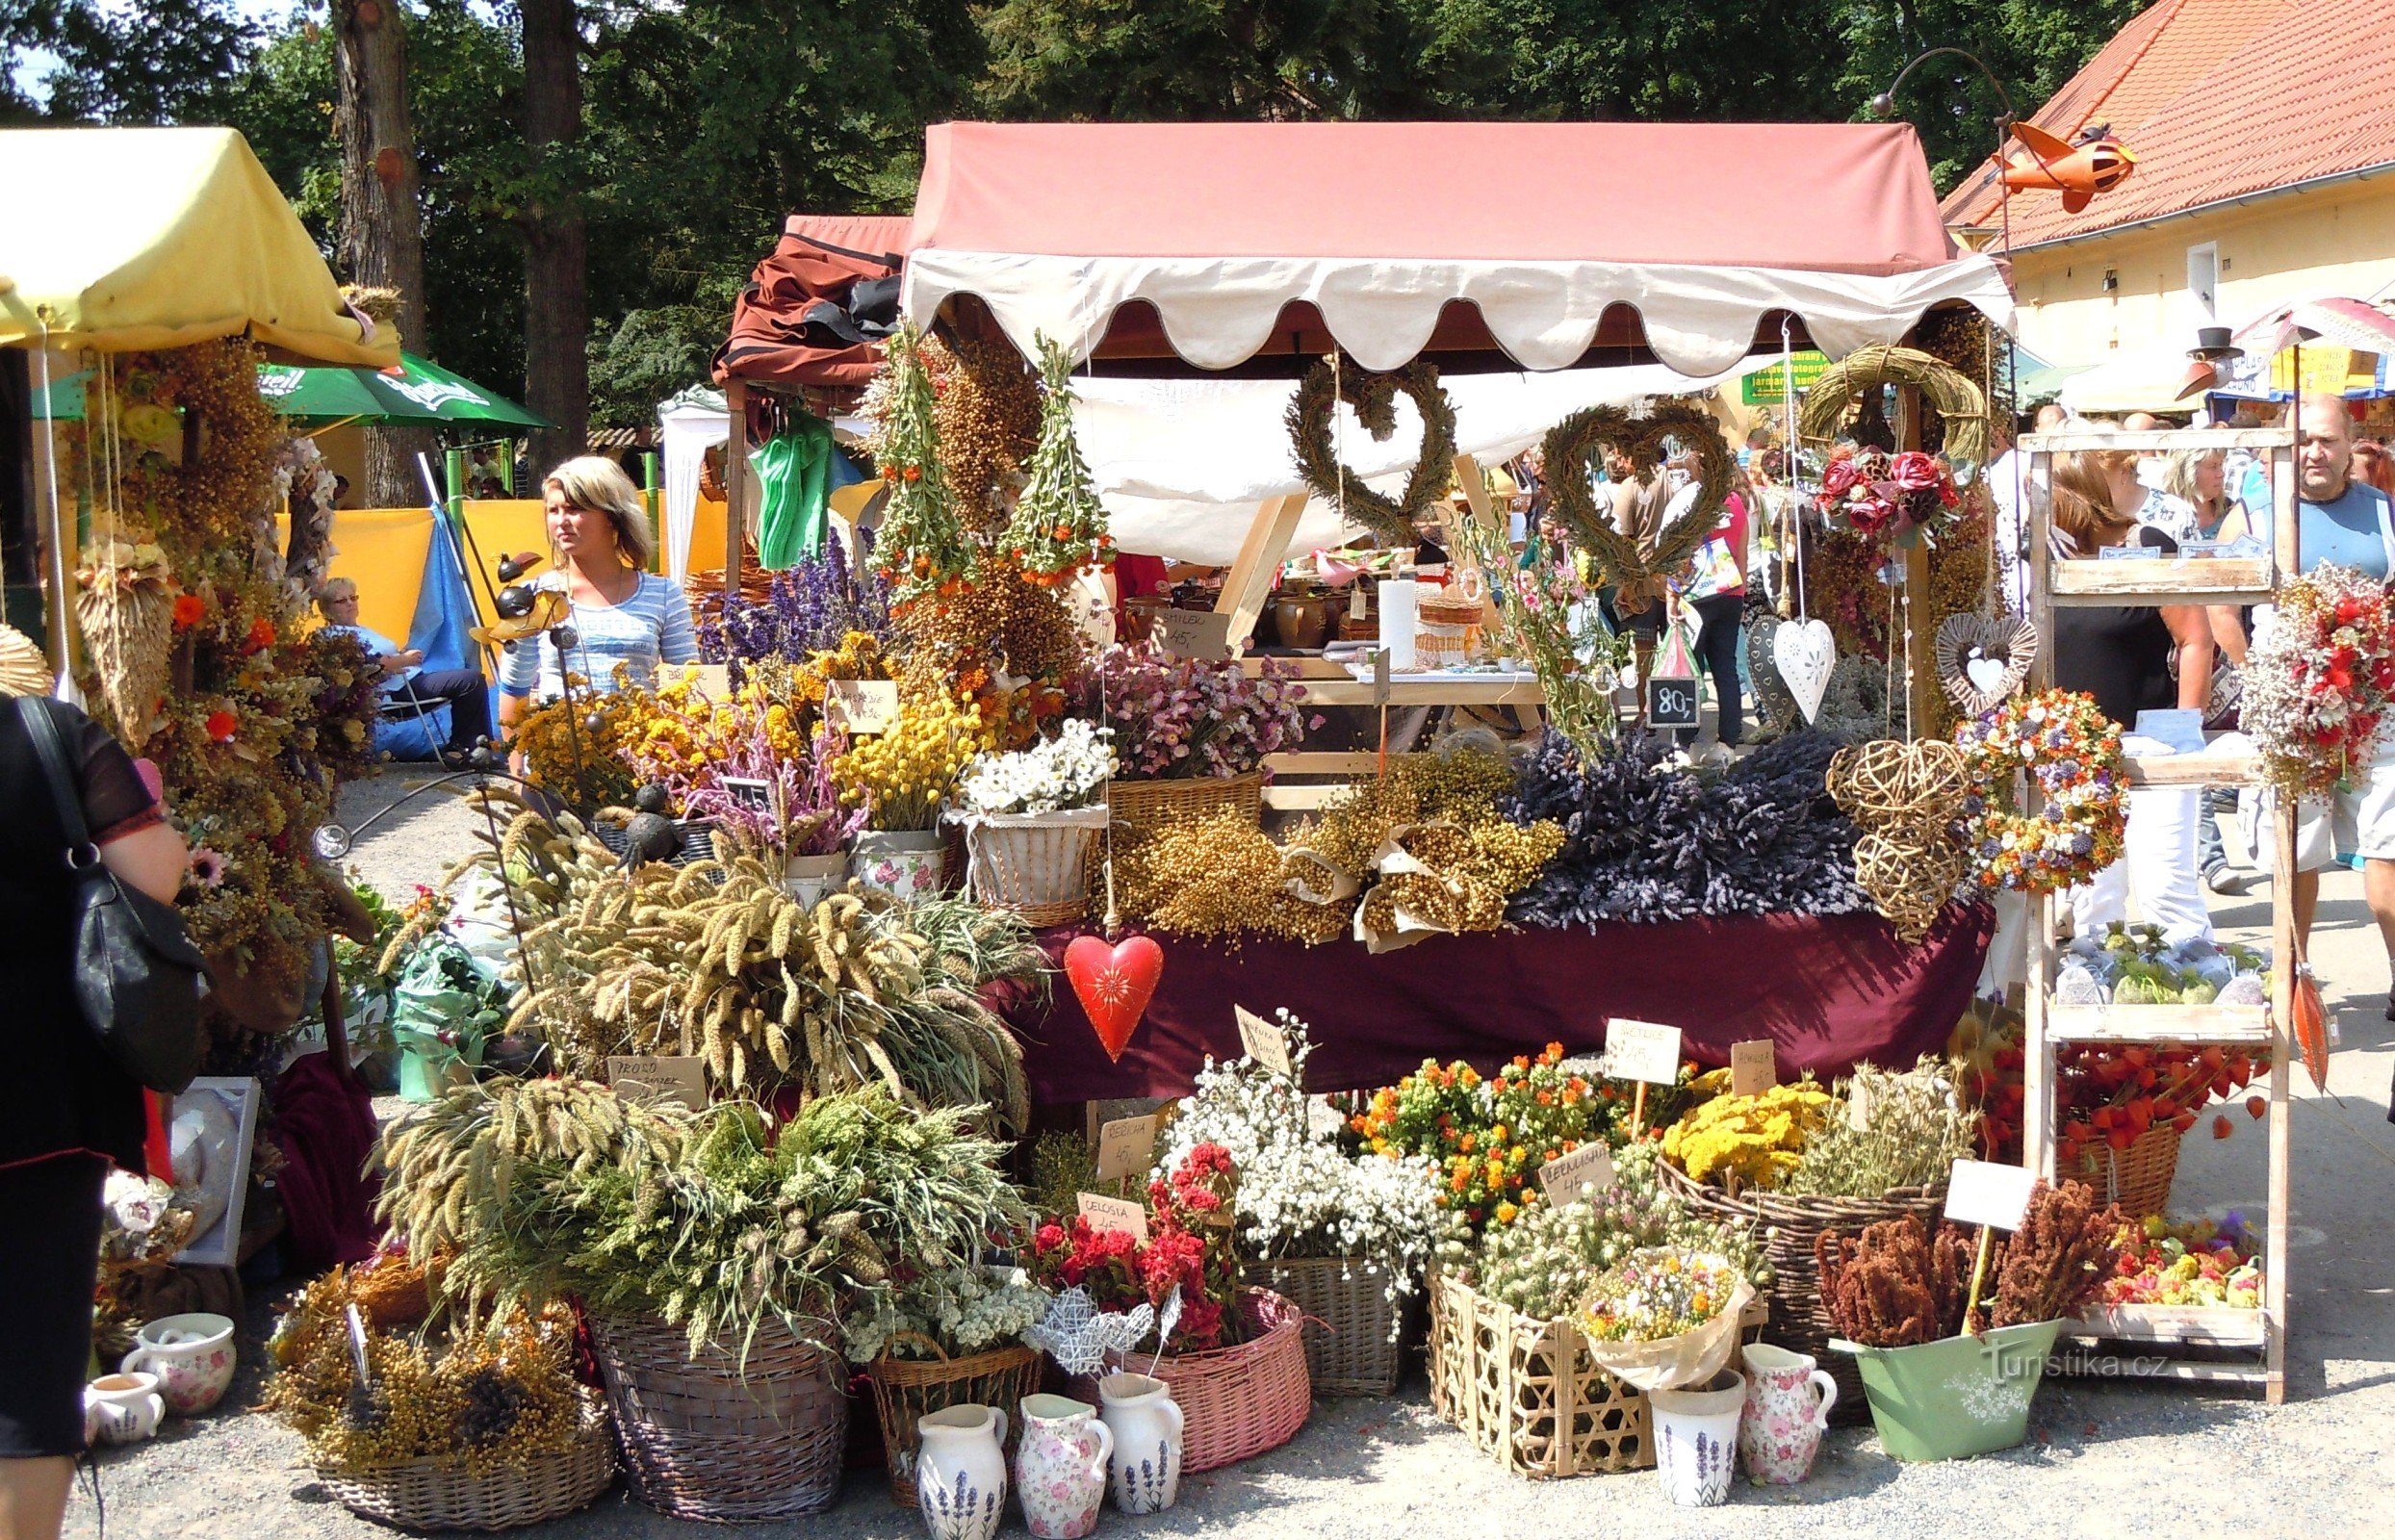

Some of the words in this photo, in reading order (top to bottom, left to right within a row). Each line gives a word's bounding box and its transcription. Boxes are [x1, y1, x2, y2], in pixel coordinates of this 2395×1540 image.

[1659, 687, 1694, 719] 80,-
[617, 1062, 657, 1073] PROSO
[1086, 1200, 1128, 1218] CELOSIA
